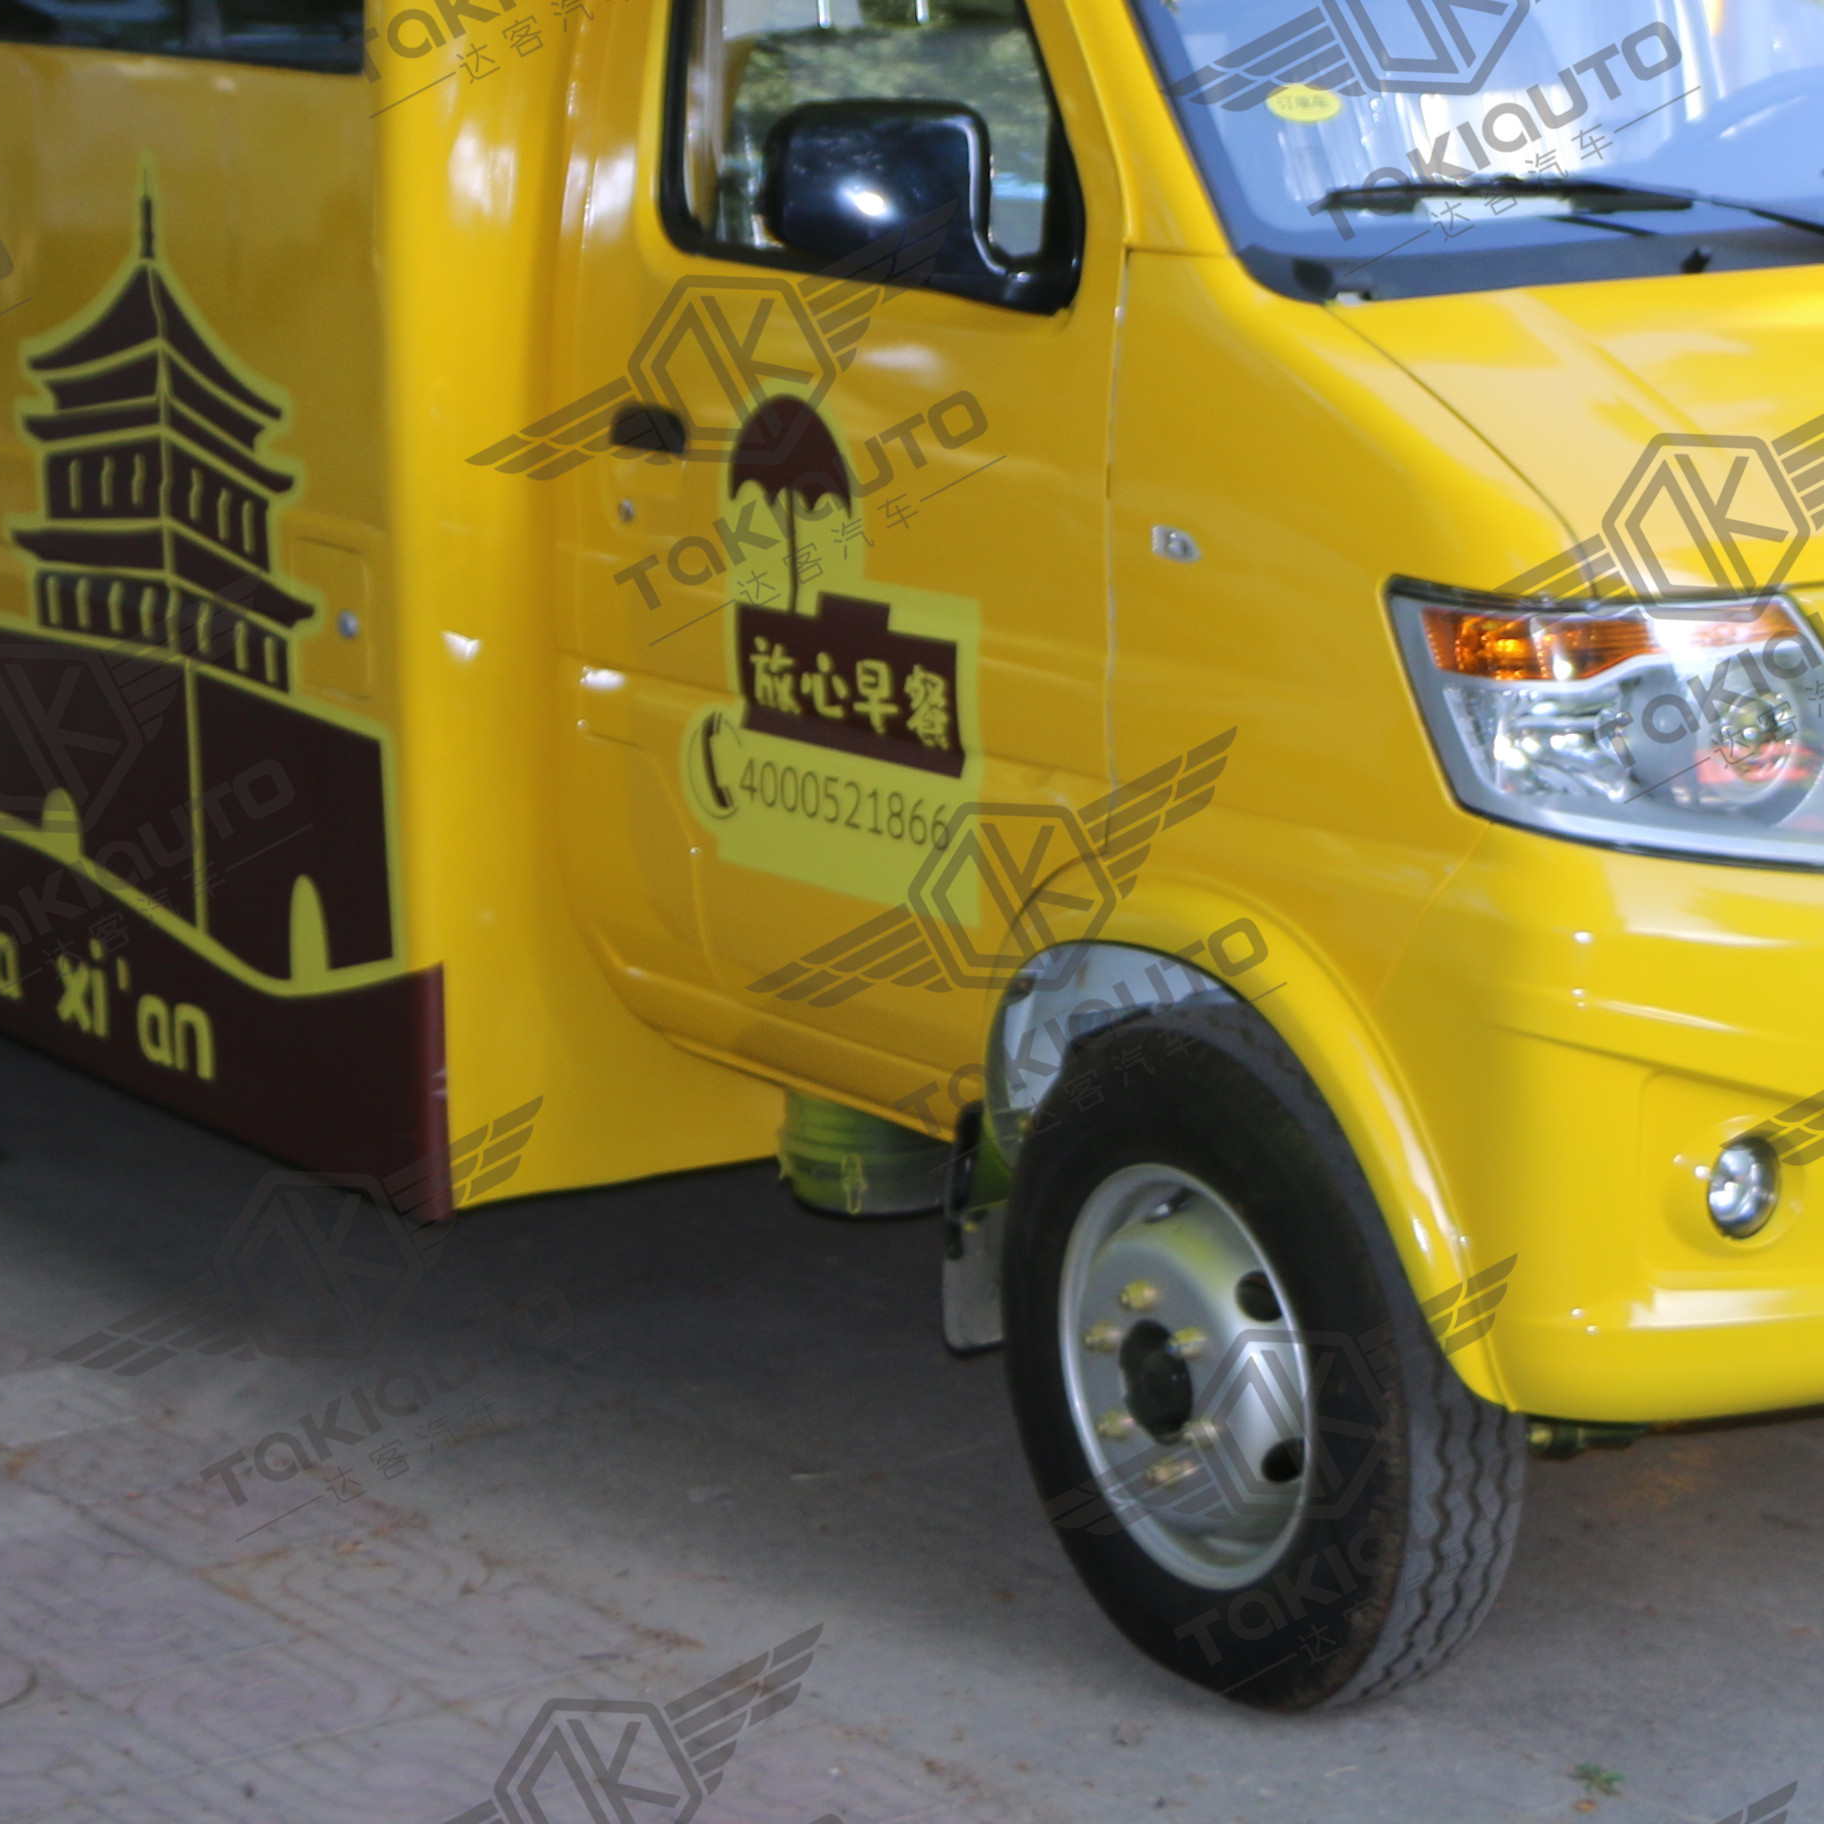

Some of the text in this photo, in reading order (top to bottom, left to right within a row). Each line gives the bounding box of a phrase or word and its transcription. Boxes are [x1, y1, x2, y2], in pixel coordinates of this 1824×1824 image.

[749, 636, 950, 751] 放心早餐
[739, 758, 950, 852] 4000521866
